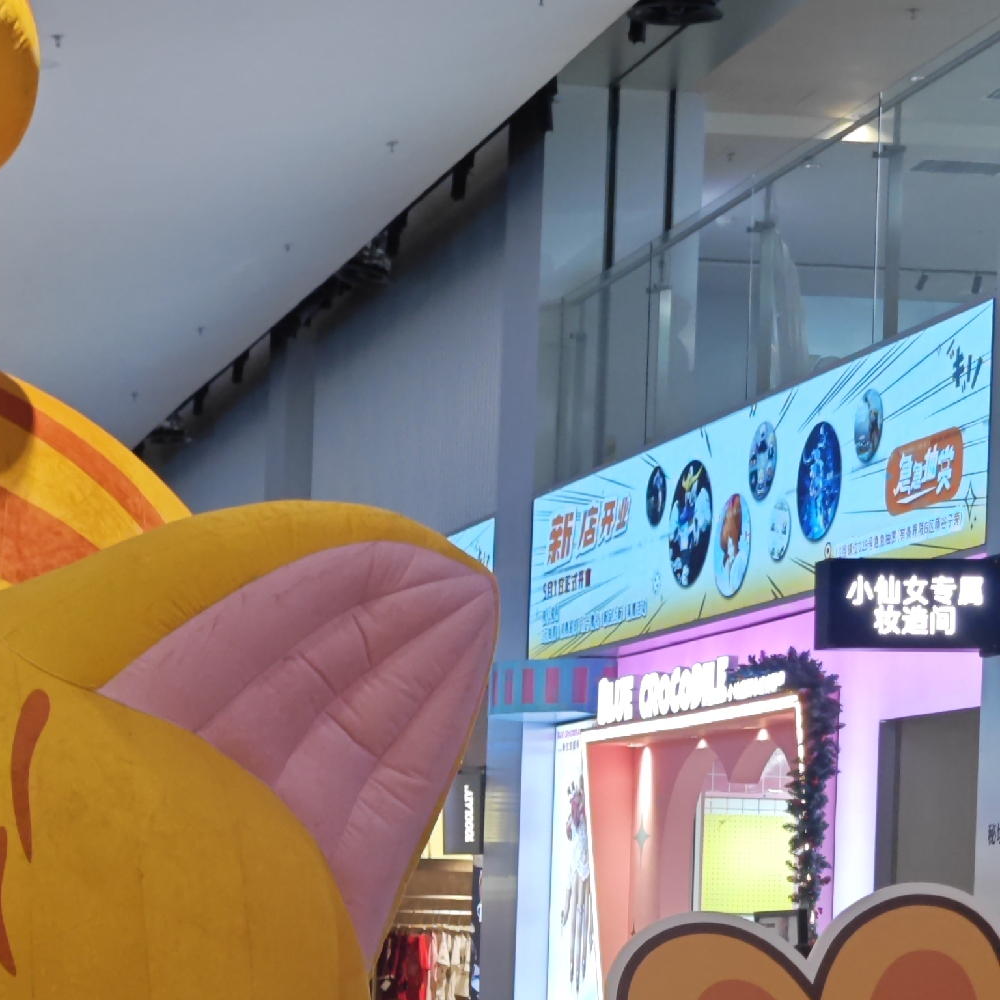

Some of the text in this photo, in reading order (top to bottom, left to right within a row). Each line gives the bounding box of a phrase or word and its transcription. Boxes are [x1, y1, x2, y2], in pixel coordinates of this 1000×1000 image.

[547, 495, 631, 566] 新店开业
[873, 605, 956, 636] 妆造间
